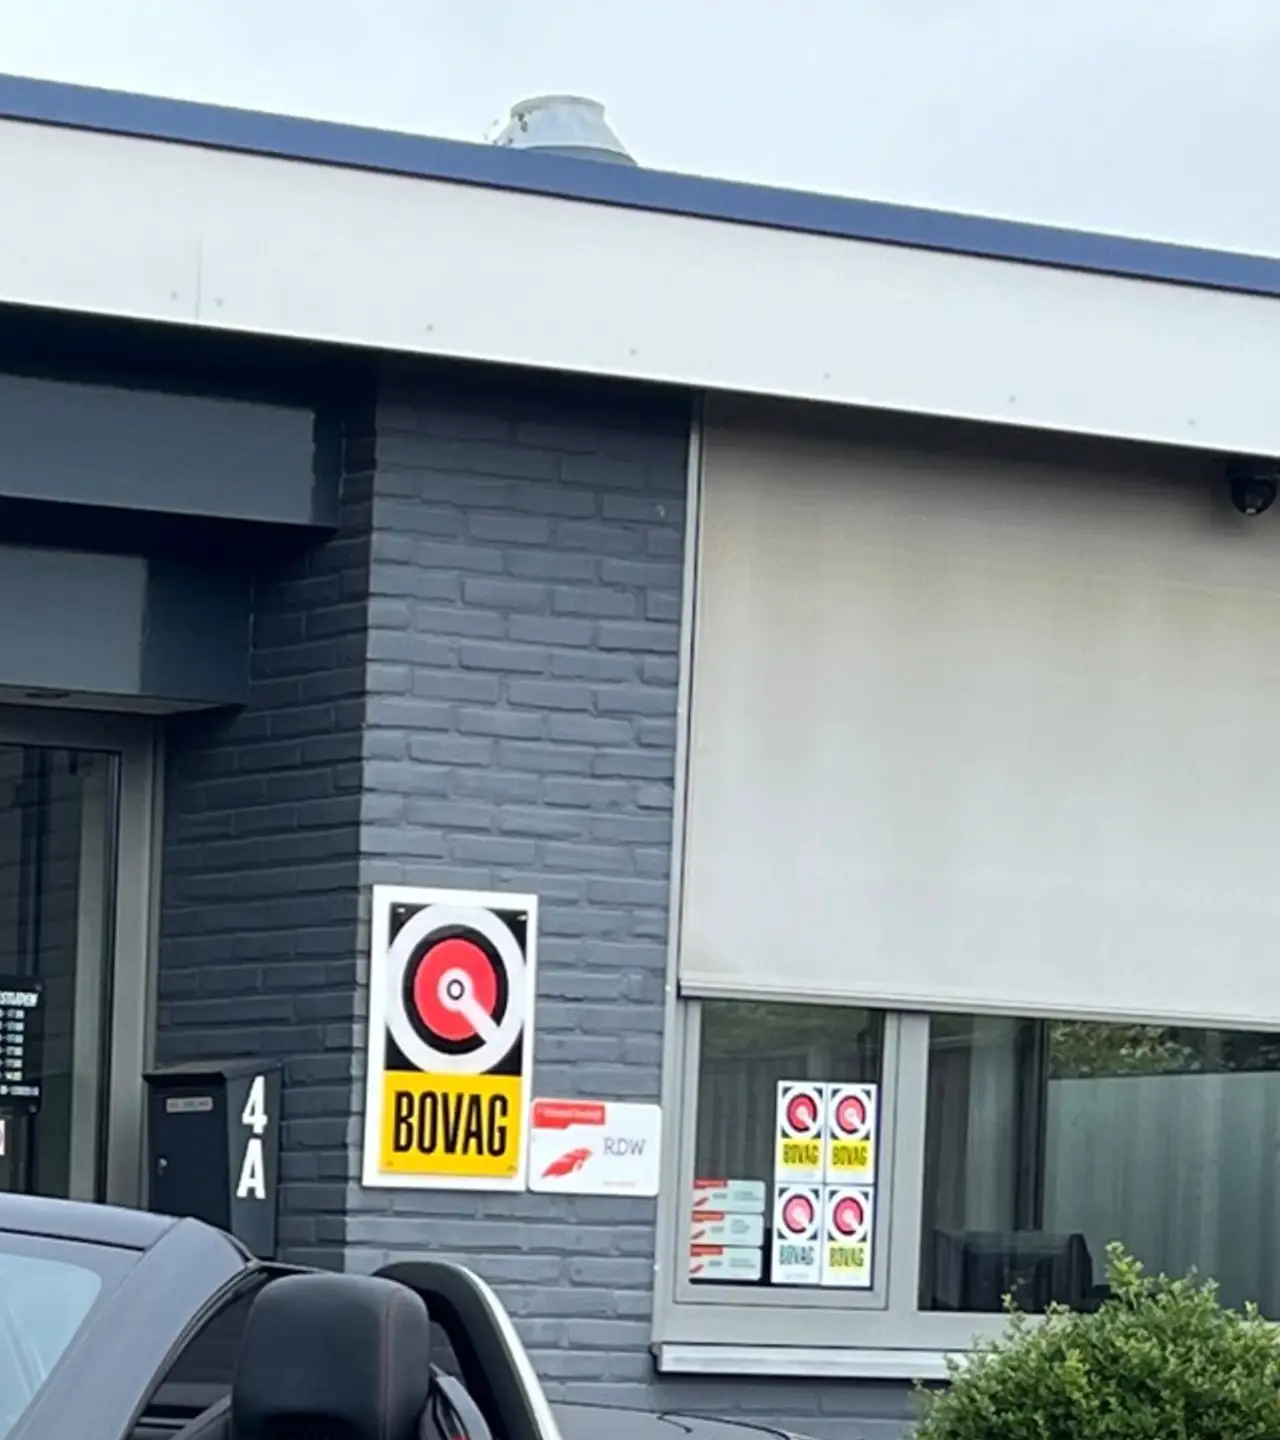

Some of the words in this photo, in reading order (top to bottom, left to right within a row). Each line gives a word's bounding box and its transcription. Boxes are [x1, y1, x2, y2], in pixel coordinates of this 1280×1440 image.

[242, 1075, 268, 1135] 4
[393, 1090, 509, 1157] BOVAG
[603, 1136, 647, 1157] RDW
[783, 1143, 819, 1165] BOVAG
[832, 1145, 868, 1166] BOVAG
[236, 1137, 266, 1199] A
[779, 1245, 814, 1266] BOVAG
[829, 1247, 864, 1268] BOVAG
